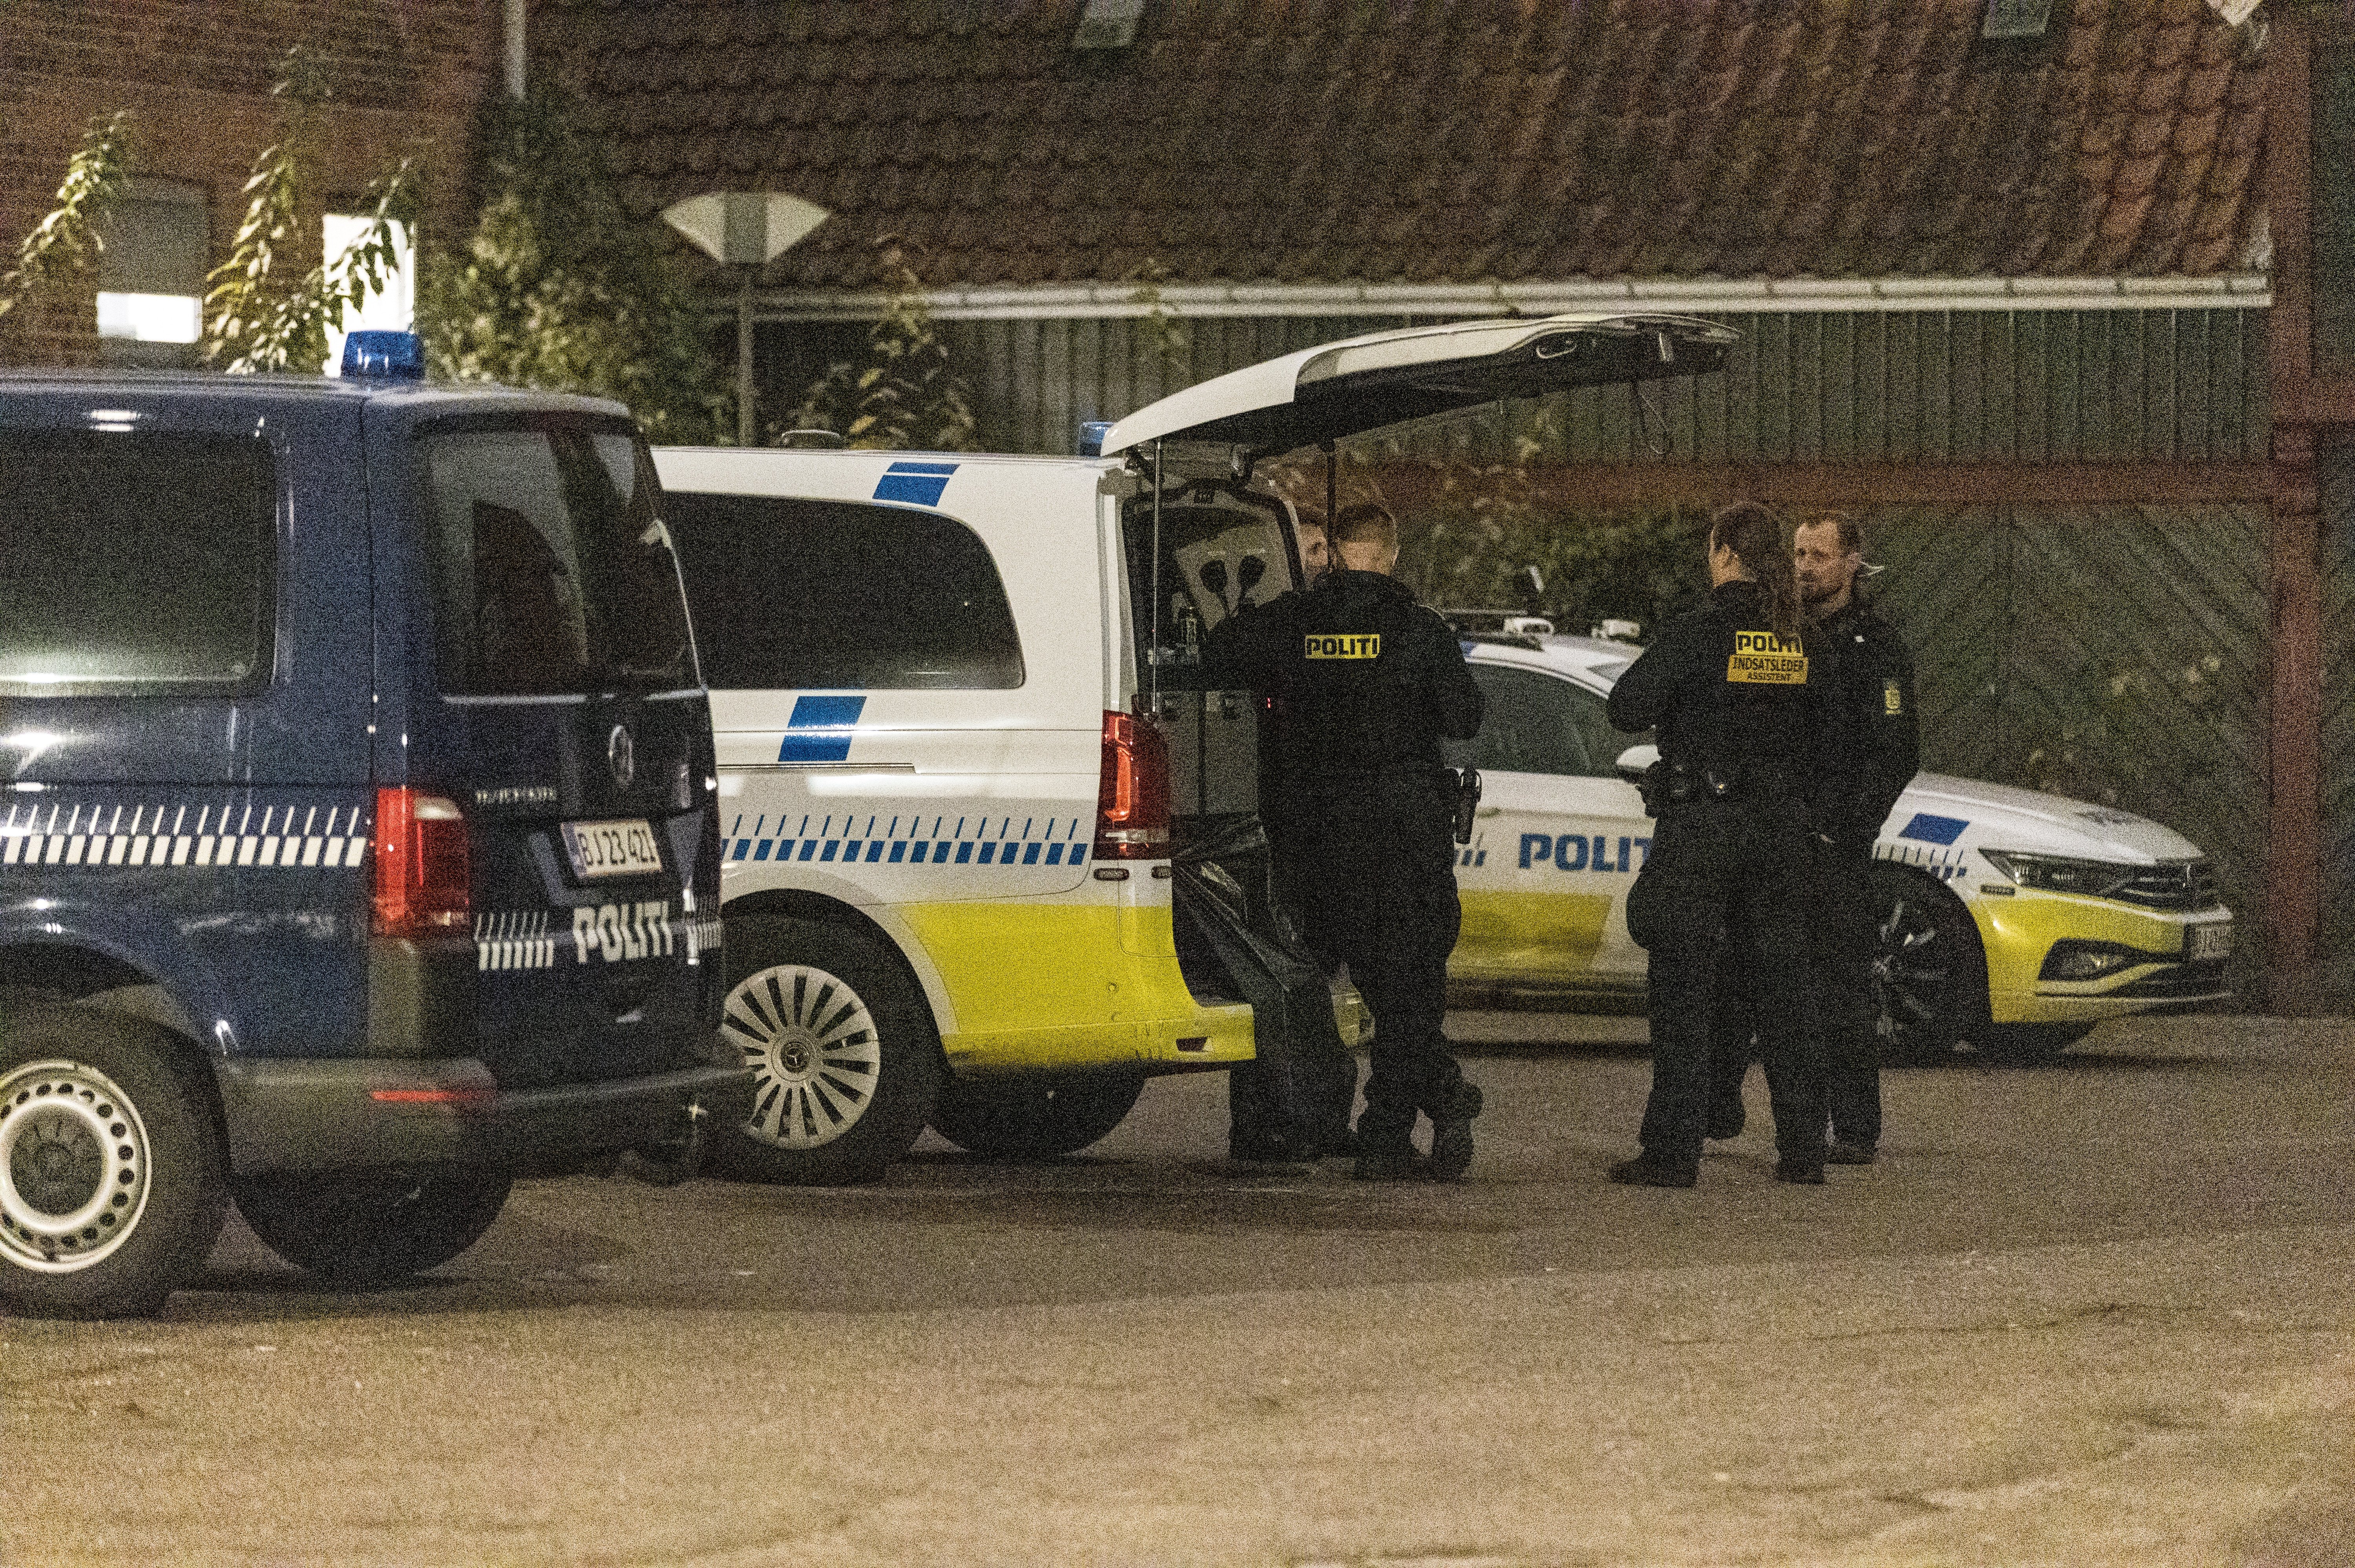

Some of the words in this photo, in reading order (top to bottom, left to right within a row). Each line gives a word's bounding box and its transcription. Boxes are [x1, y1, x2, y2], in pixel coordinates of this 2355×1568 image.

[1306, 638, 1378, 656] POLITI
[1732, 657, 1804, 672] INDSATSLEDER
[1747, 672, 1792, 681] ASSISTENT
[1519, 833, 1653, 873] POLIT
[573, 901, 672, 964] POLITI
